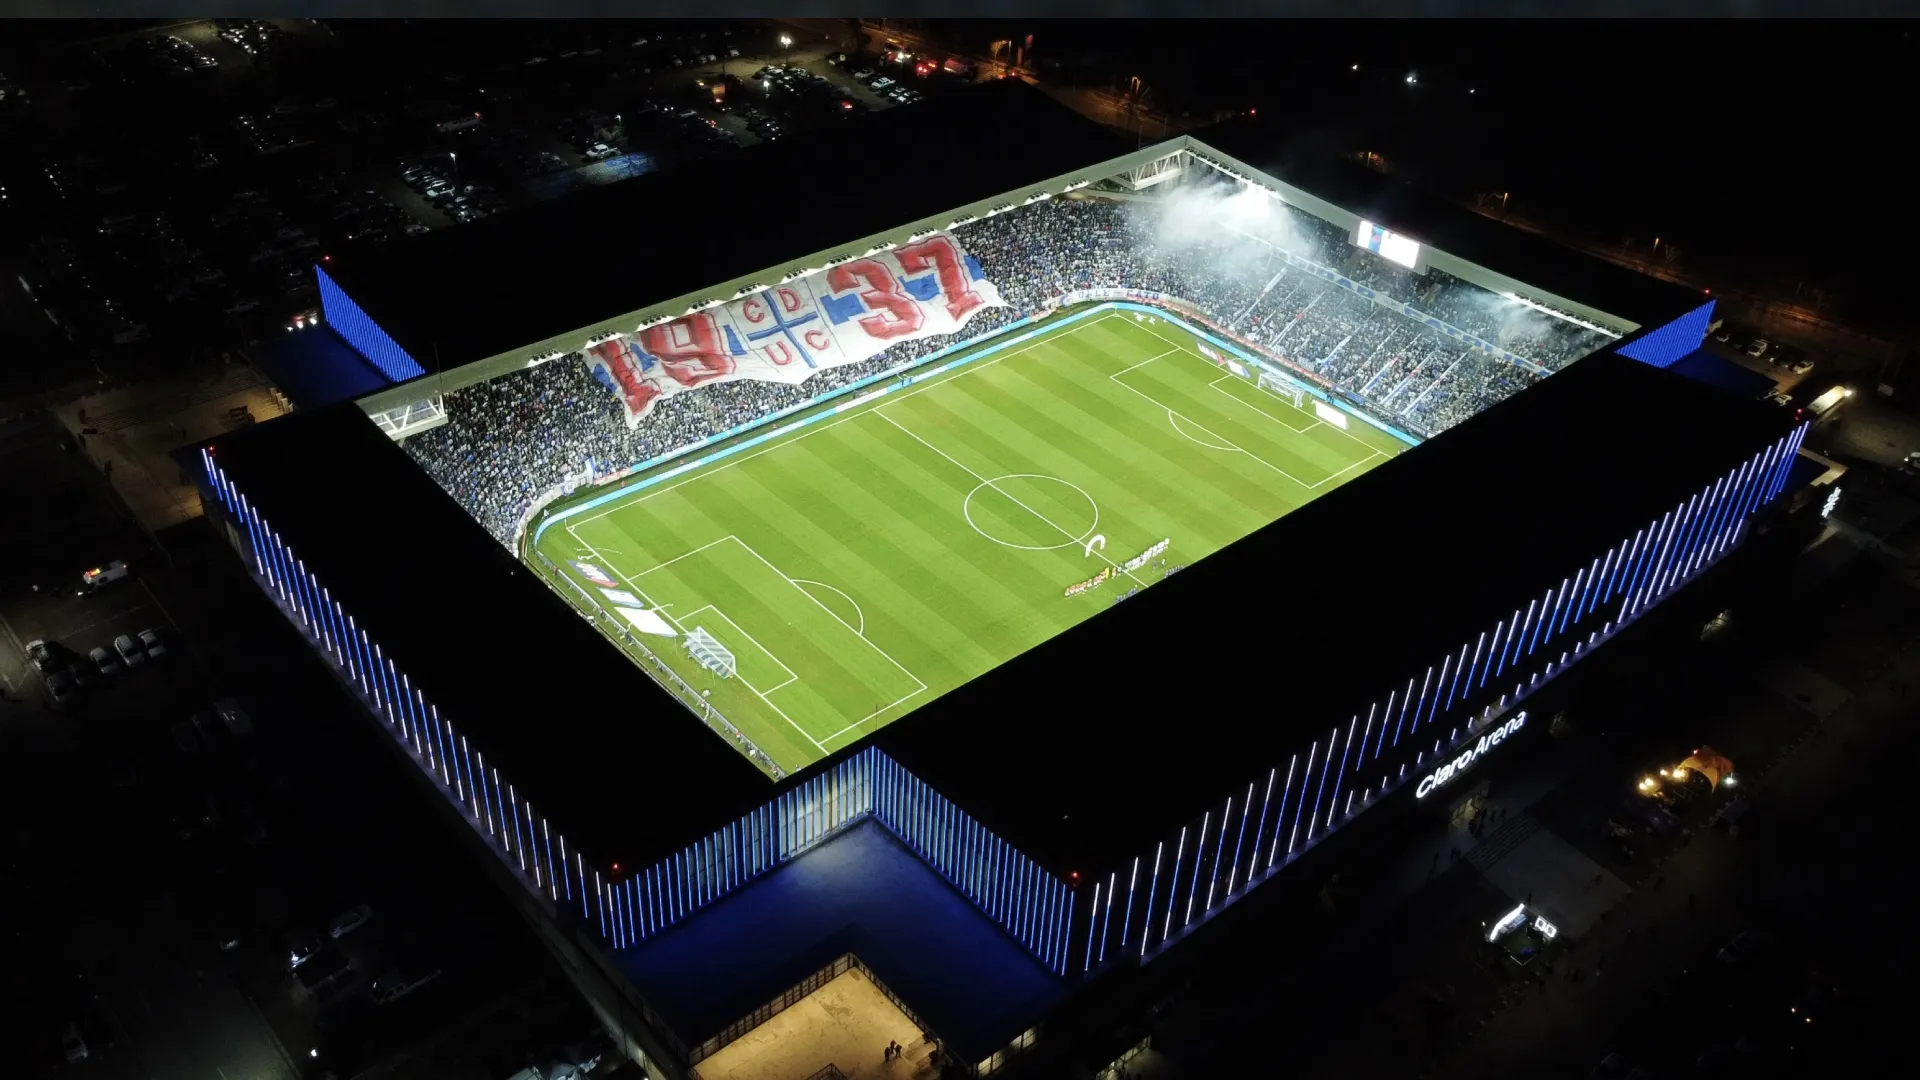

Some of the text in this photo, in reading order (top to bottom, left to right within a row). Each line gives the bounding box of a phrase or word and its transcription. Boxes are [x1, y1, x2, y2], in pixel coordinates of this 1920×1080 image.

[828, 236, 984, 339] 37
[1416, 711, 1526, 798] Claro Arena
